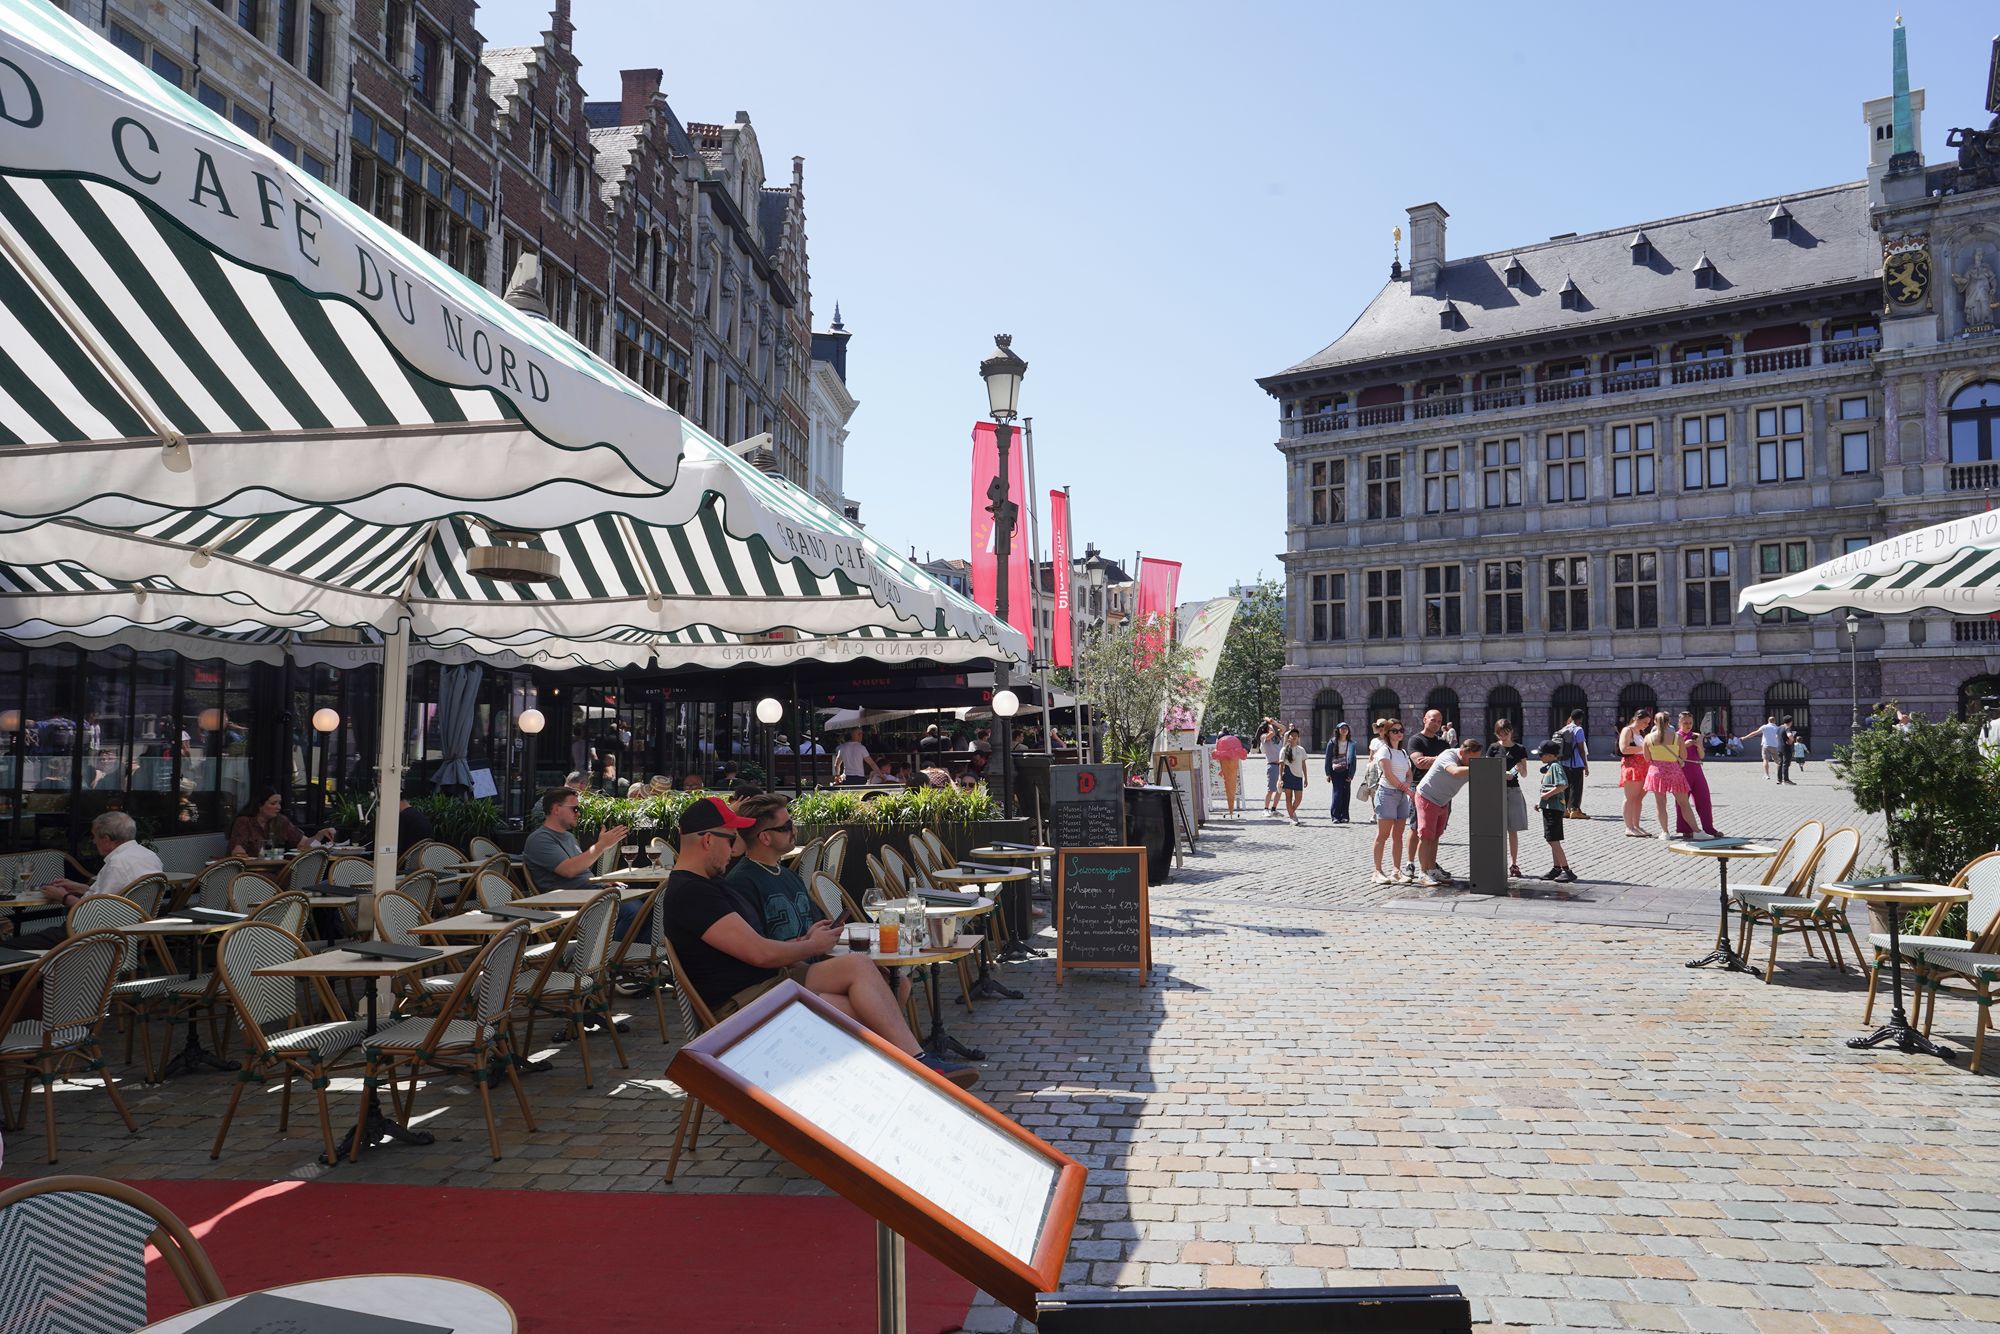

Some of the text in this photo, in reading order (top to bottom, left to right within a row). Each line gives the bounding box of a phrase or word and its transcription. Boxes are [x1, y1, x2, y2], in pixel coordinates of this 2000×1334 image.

[355, 244, 416, 325] DU
[441, 304, 550, 403] NORD
[776, 522, 828, 562] GRAND
[835, 542, 867, 569] CAF
[1819, 549, 1872, 579] GRAND
[1935, 524, 1959, 548] DU
[1969, 514, 1998, 540] NO
